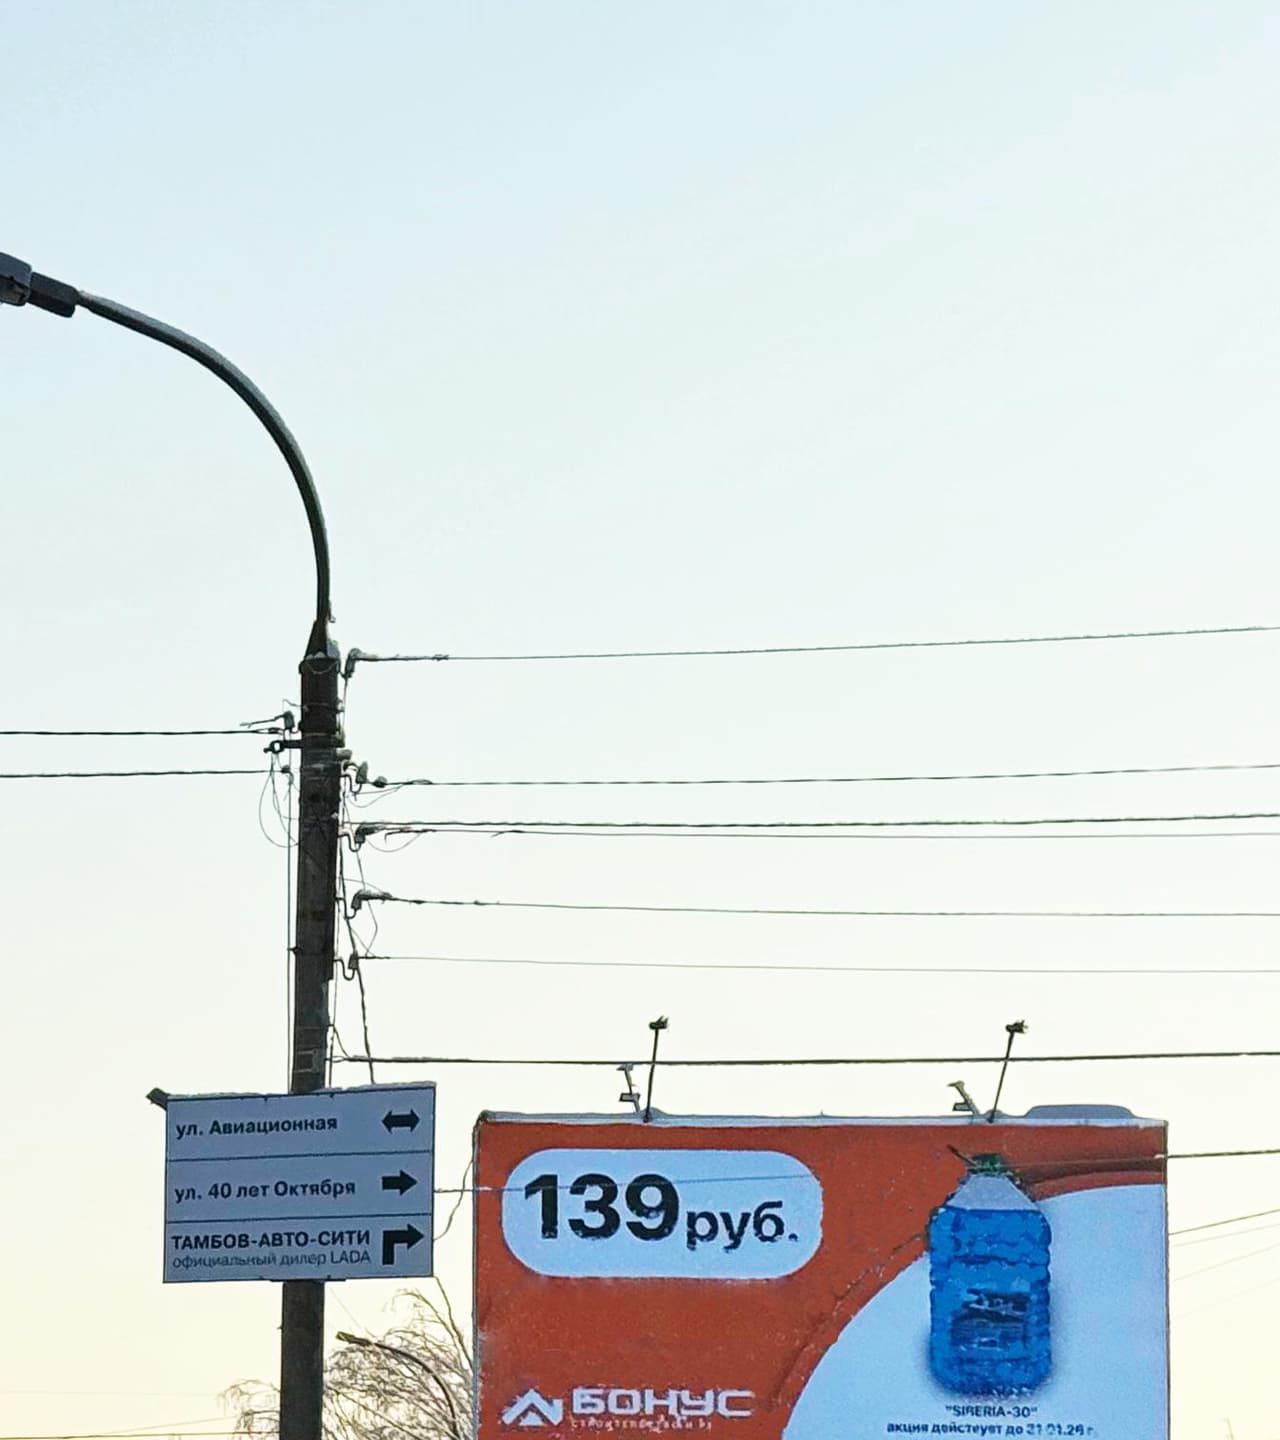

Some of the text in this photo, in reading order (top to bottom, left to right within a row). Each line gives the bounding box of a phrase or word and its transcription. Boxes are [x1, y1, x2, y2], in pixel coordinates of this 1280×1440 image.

[176, 1117, 338, 1140] ул. Авиационная
[174, 1179, 356, 1204] ул. 40 лет Октября
[524, 1173, 799, 1253] 139 руб.
[171, 1230, 371, 1250] ТАМБОВ-АВТО-СИТИ
[172, 1250, 371, 1269] официальный дилер LADA
[572, 1387, 755, 1418] БОНУС
